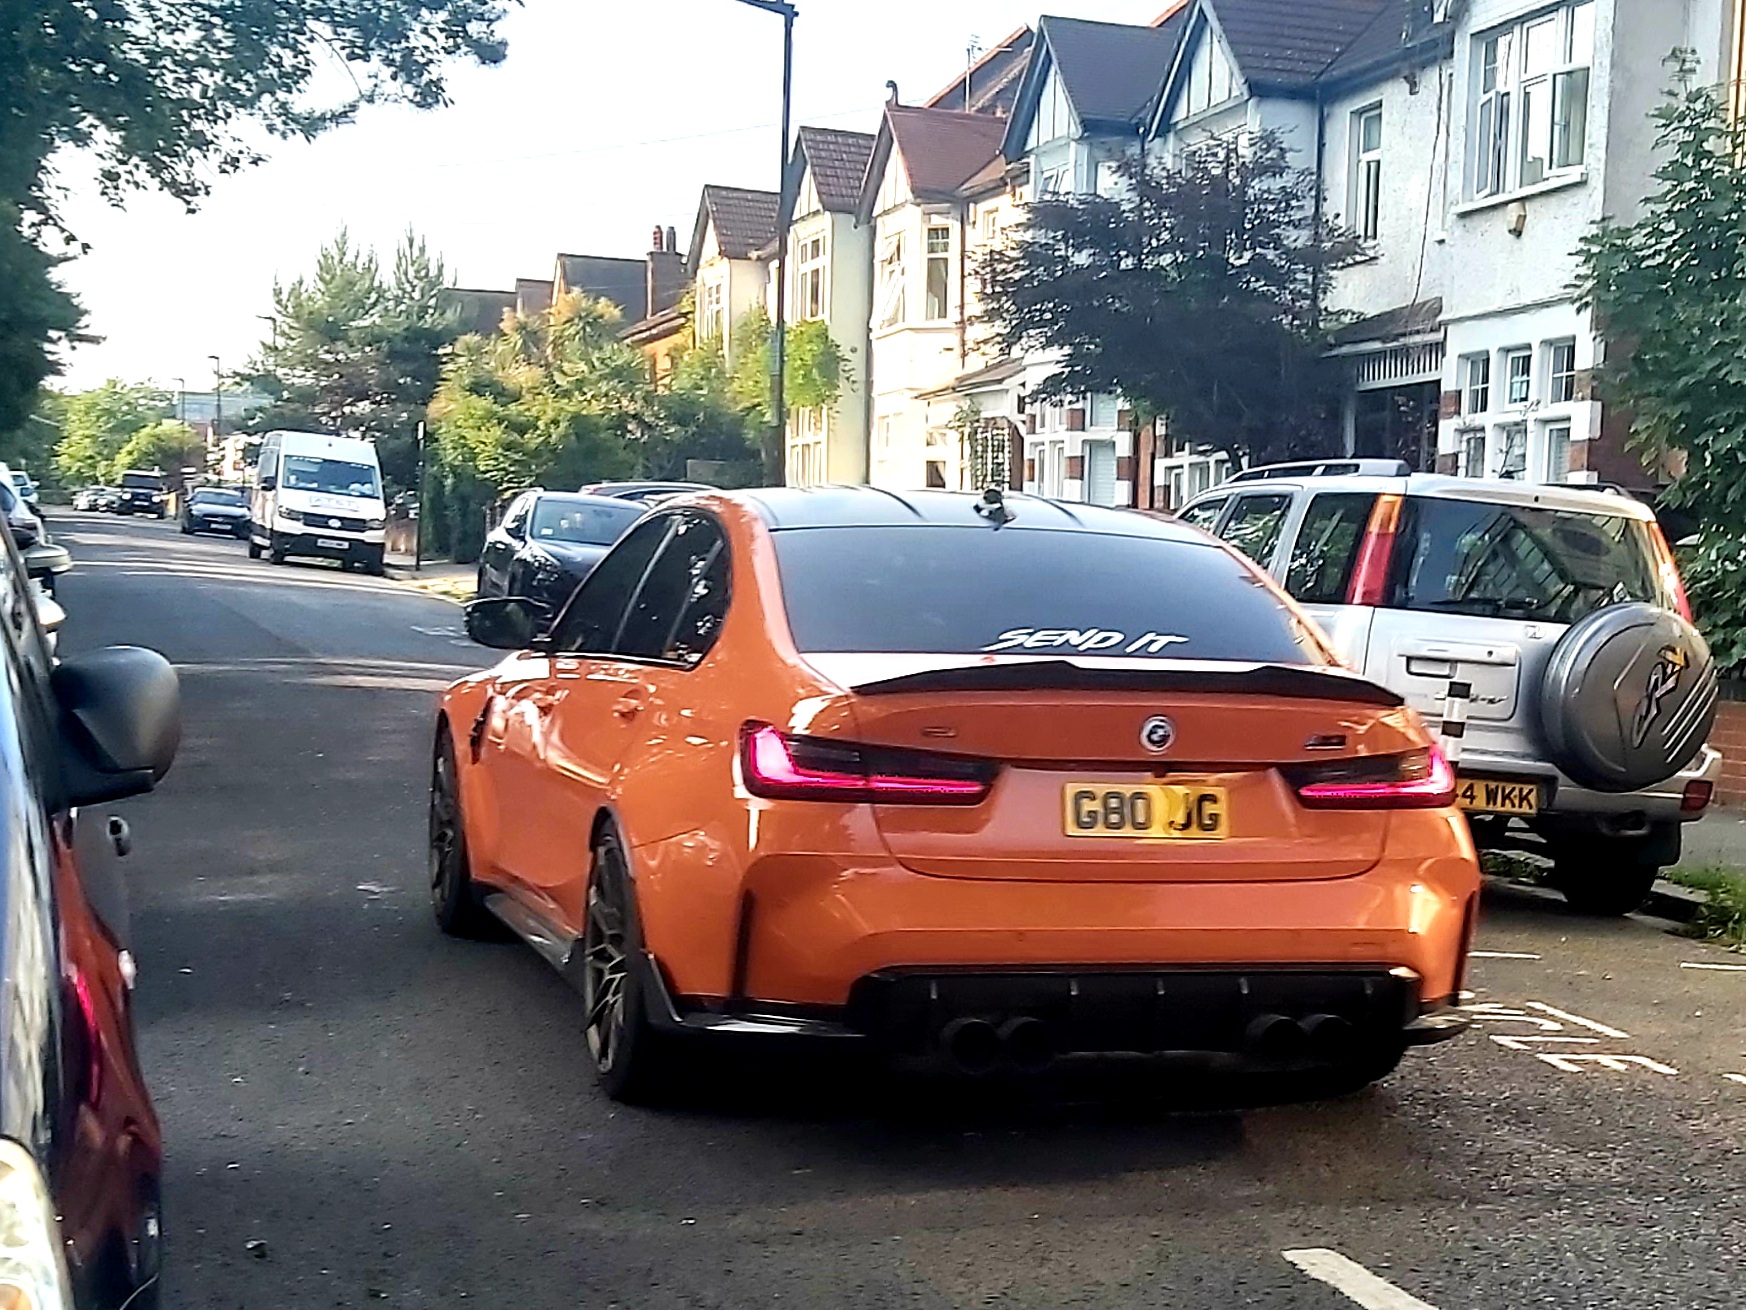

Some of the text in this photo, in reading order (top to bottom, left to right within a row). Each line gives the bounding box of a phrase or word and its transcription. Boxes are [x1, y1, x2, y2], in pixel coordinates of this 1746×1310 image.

[980, 628, 1190, 653] SEND IT
[1074, 790, 1152, 830] G80
[1456, 782, 1534, 810] 4 WKK
